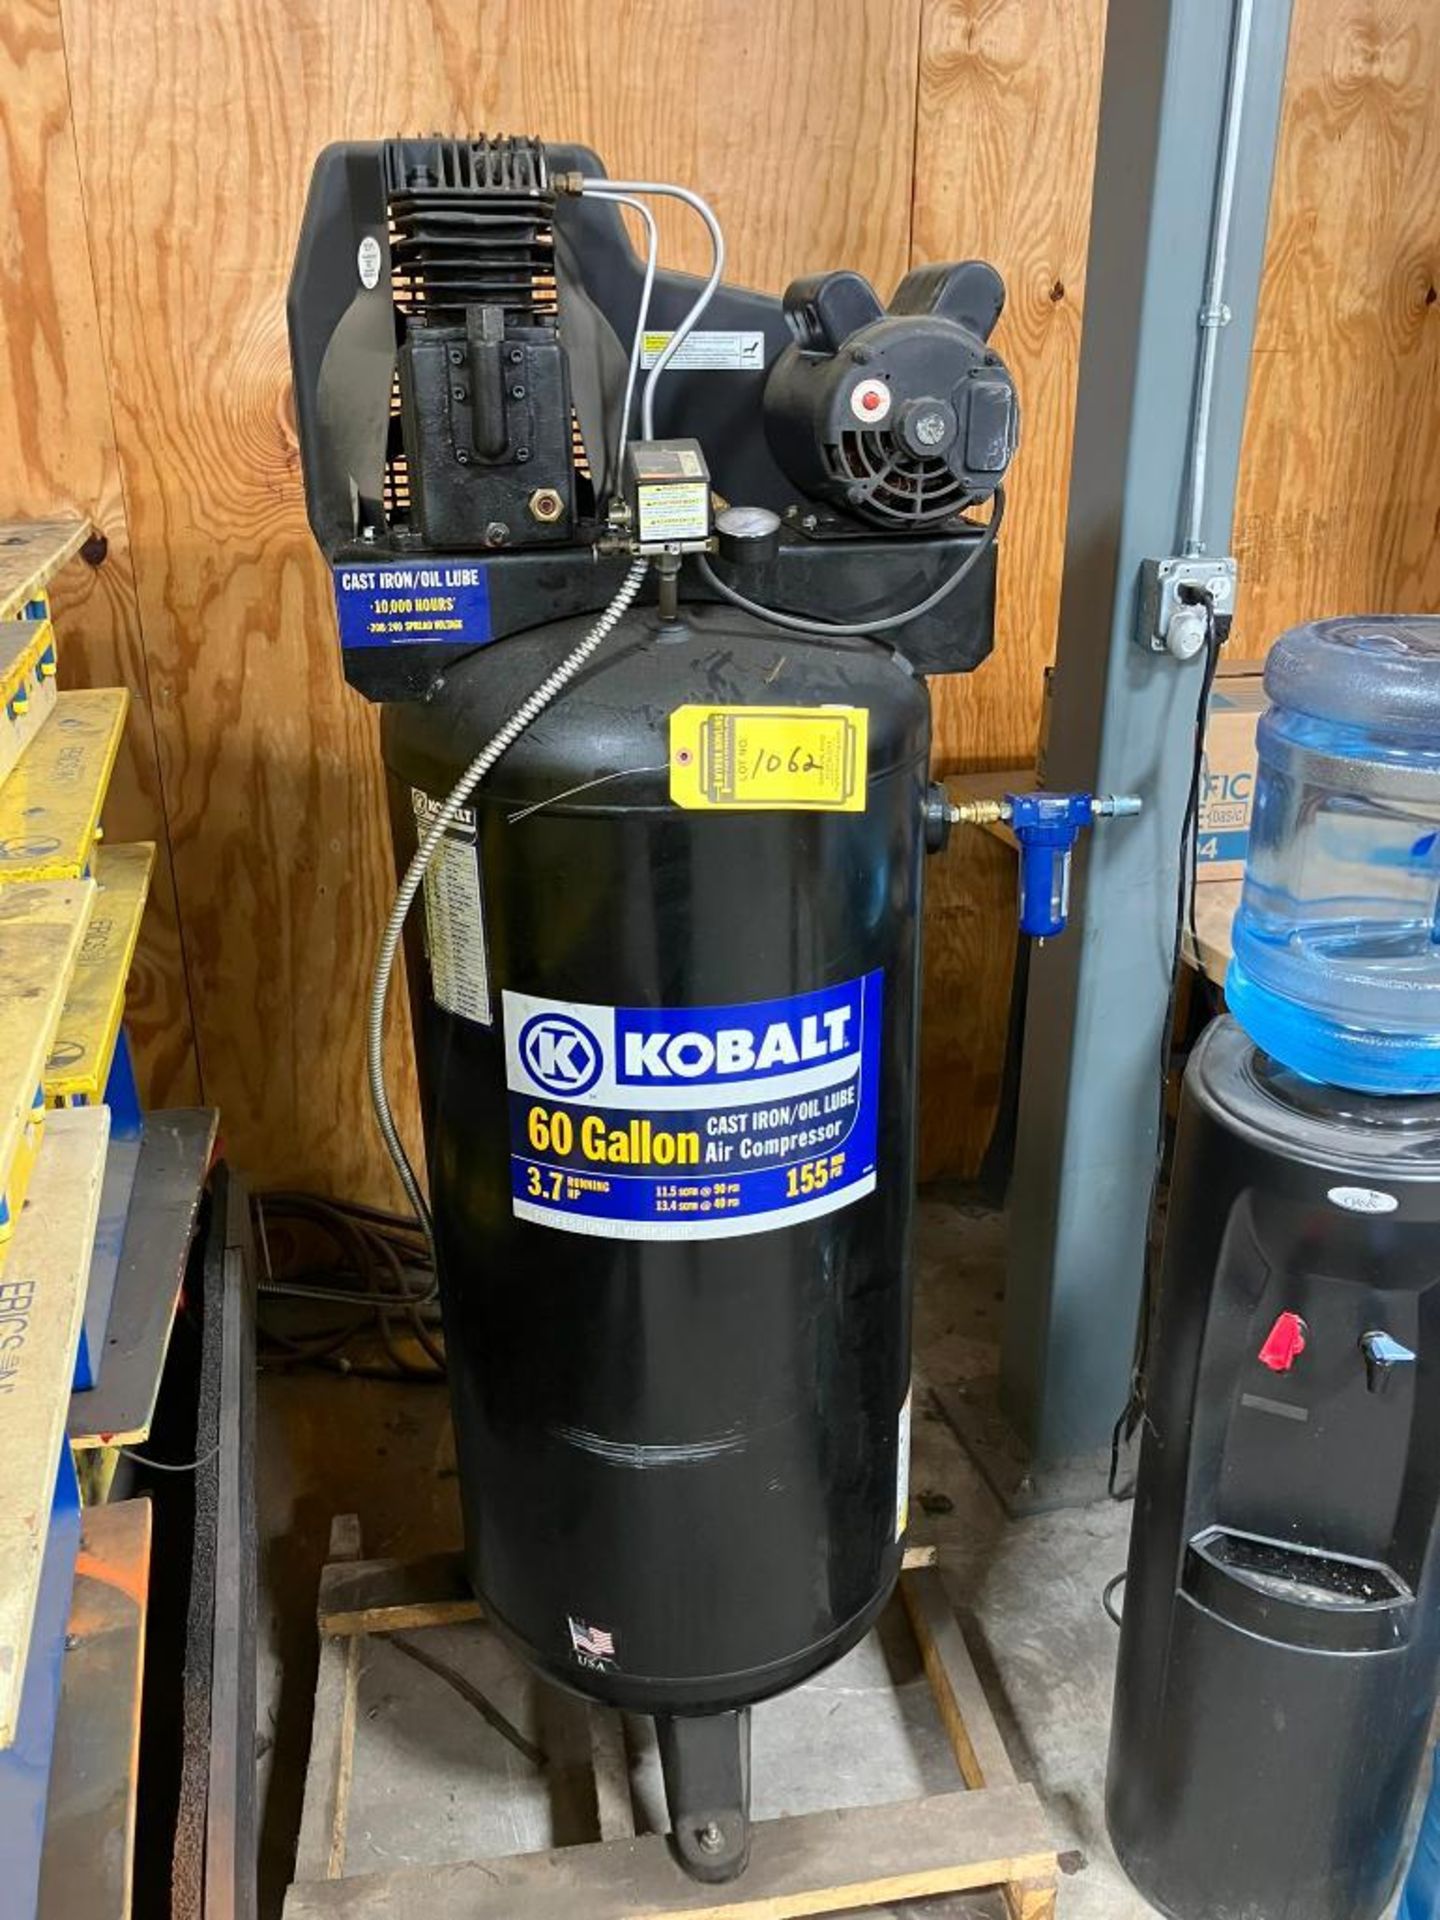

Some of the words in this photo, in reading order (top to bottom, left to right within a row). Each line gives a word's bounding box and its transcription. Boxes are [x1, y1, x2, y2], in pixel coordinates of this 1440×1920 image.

[342, 572, 375, 590] CAST
[380, 570, 443, 589] IRON/OIL
[445, 569, 479, 587] LUBE
[374, 599, 412, 614] 10,000
[738, 761, 748, 782] LOT
[752, 746, 823, 780] 1062
[1203, 772, 1252, 801] FIC
[624, 1005, 851, 1077] KOBALT
[707, 1112, 748, 1136] CAST
[752, 1099, 821, 1130] IRON/OIL
[824, 1085, 855, 1114] LUBE
[528, 1106, 573, 1156] 60
[581, 1115, 699, 1165] Gallon
[705, 1140, 733, 1164] Air
[740, 1119, 843, 1159] Compressor
[527, 1166, 564, 1201] 3.7
[656, 1185, 677, 1198] 11.5
[786, 1158, 829, 1198] 155
[656, 1199, 677, 1211] 13.4
[578, 1656, 606, 1672] USA
